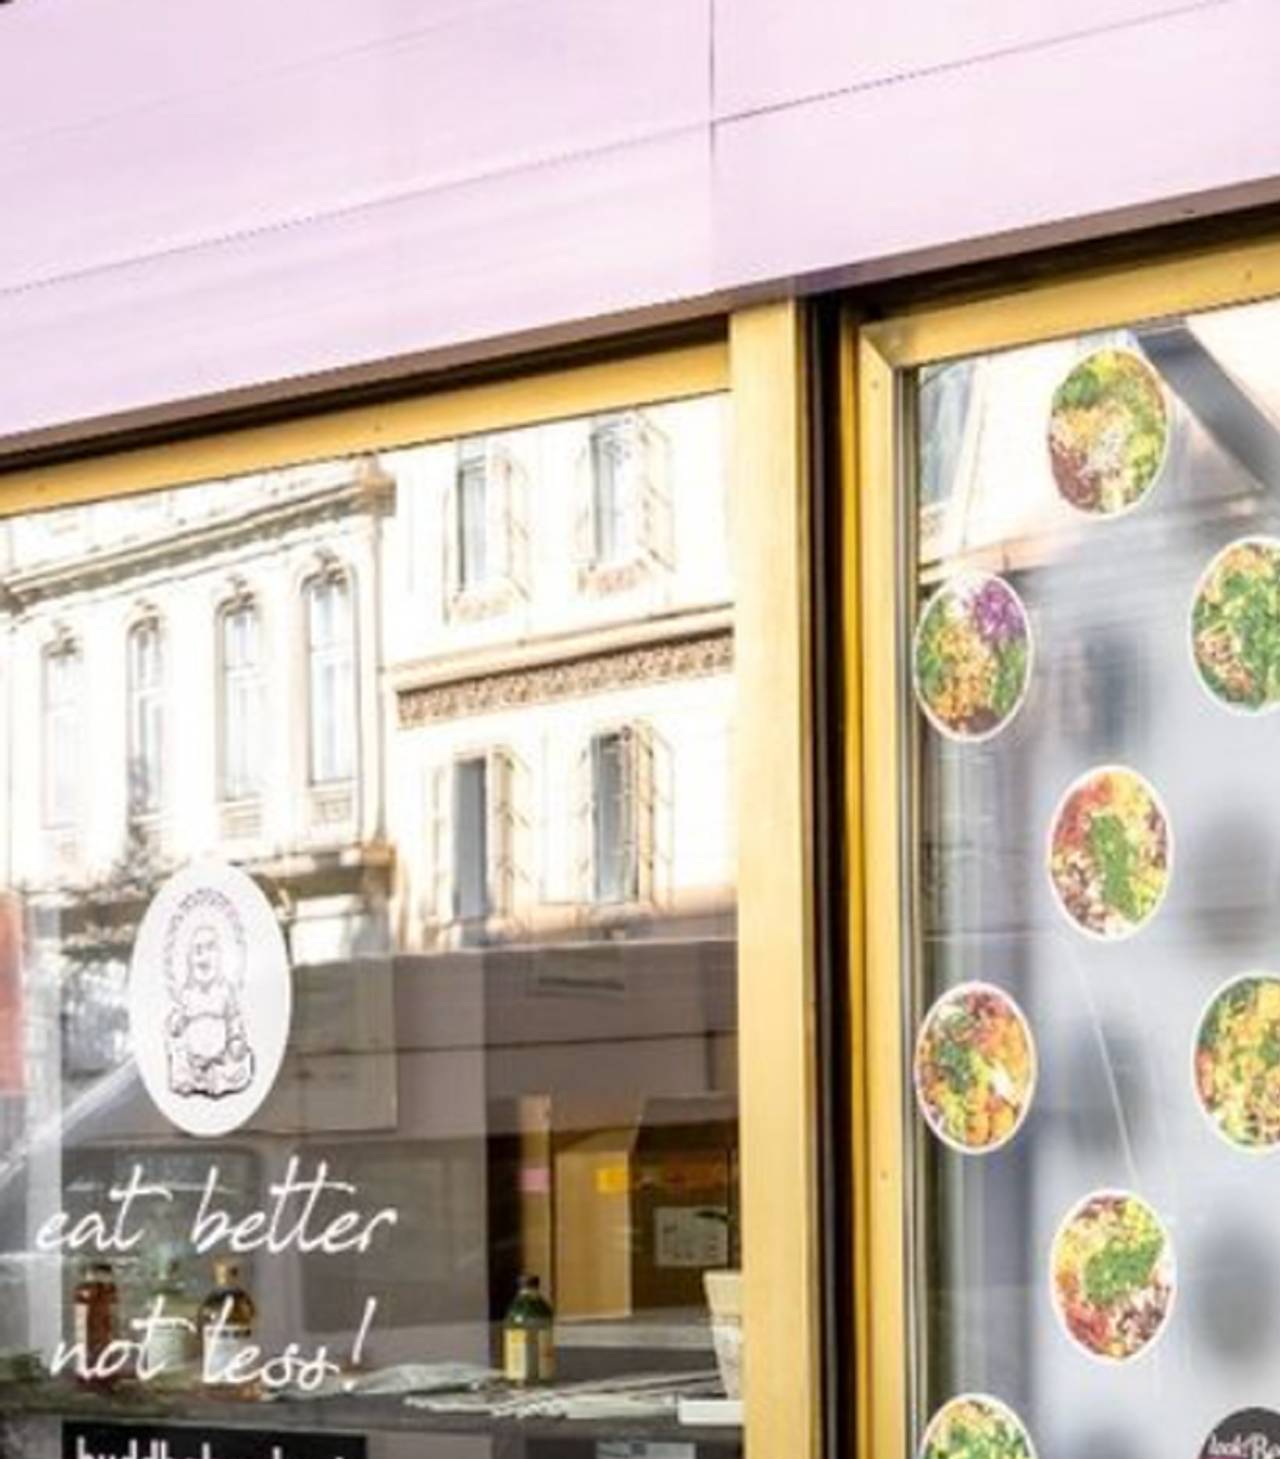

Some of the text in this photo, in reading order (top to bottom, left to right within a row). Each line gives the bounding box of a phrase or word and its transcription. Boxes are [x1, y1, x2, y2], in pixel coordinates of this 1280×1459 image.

[36, 1155, 398, 1253] eat better
[50, 1295, 195, 1381] not
